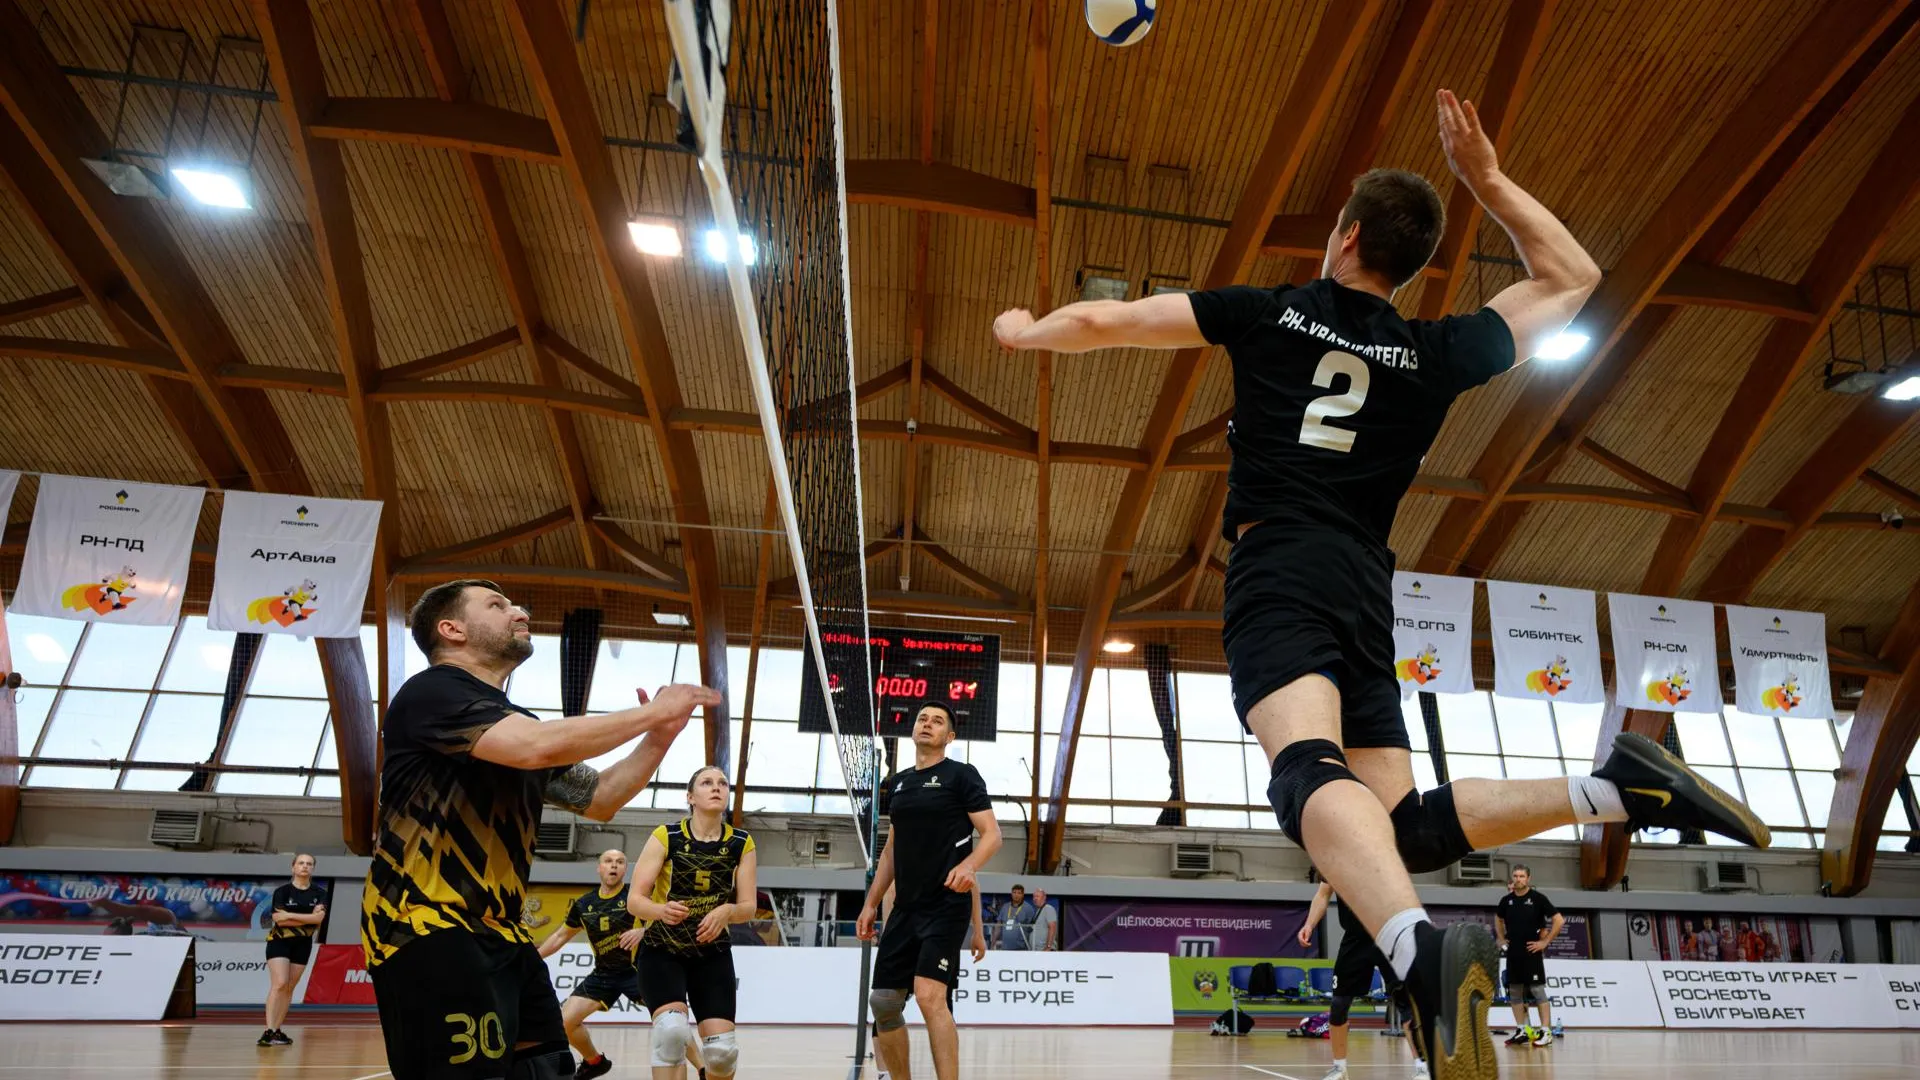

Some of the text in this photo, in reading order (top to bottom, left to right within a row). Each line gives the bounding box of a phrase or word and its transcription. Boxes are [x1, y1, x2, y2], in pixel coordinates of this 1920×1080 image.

[1298, 350, 1370, 453] 2
[80, 534, 144, 553] РН-ПД
[250, 548, 336, 564] АртАвиа
[1396, 617, 1455, 632] ПЗ_ОГПЗ
[1508, 628, 1584, 644] СИБИНТЕК
[1643, 640, 1688, 653] РН-СМ
[1740, 646, 1818, 663] Удмуртнефть
[949, 680, 977, 699] 24
[694, 870, 711, 892] 5
[1117, 915, 1272, 931] ЩЁЛКОВСКОЕ ТЕЛЕВИДЕНИЕ
[0, 945, 102, 960] ПОРТЕ
[195, 960, 222, 971] КОЙ
[0, 969, 102, 985] АБОТЕ!
[976, 969, 991, 982] В
[998, 969, 1089, 983] СПОРТЕ
[1546, 976, 1597, 989] ОРТЕ
[1662, 970, 1765, 983] РОСНЕФТЬ
[1768, 971, 1837, 983] ИГРАЕТ
[976, 990, 991, 1003] В
[998, 990, 1074, 1006] ТРУДЕ
[1551, 995, 1609, 1008] БОТЕ!
[1668, 988, 1771, 1001] РОСНЕФТЬ
[1674, 1007, 1806, 1020] ВЫИГРЫВАЕТ
[445, 1012, 507, 1065] 30
